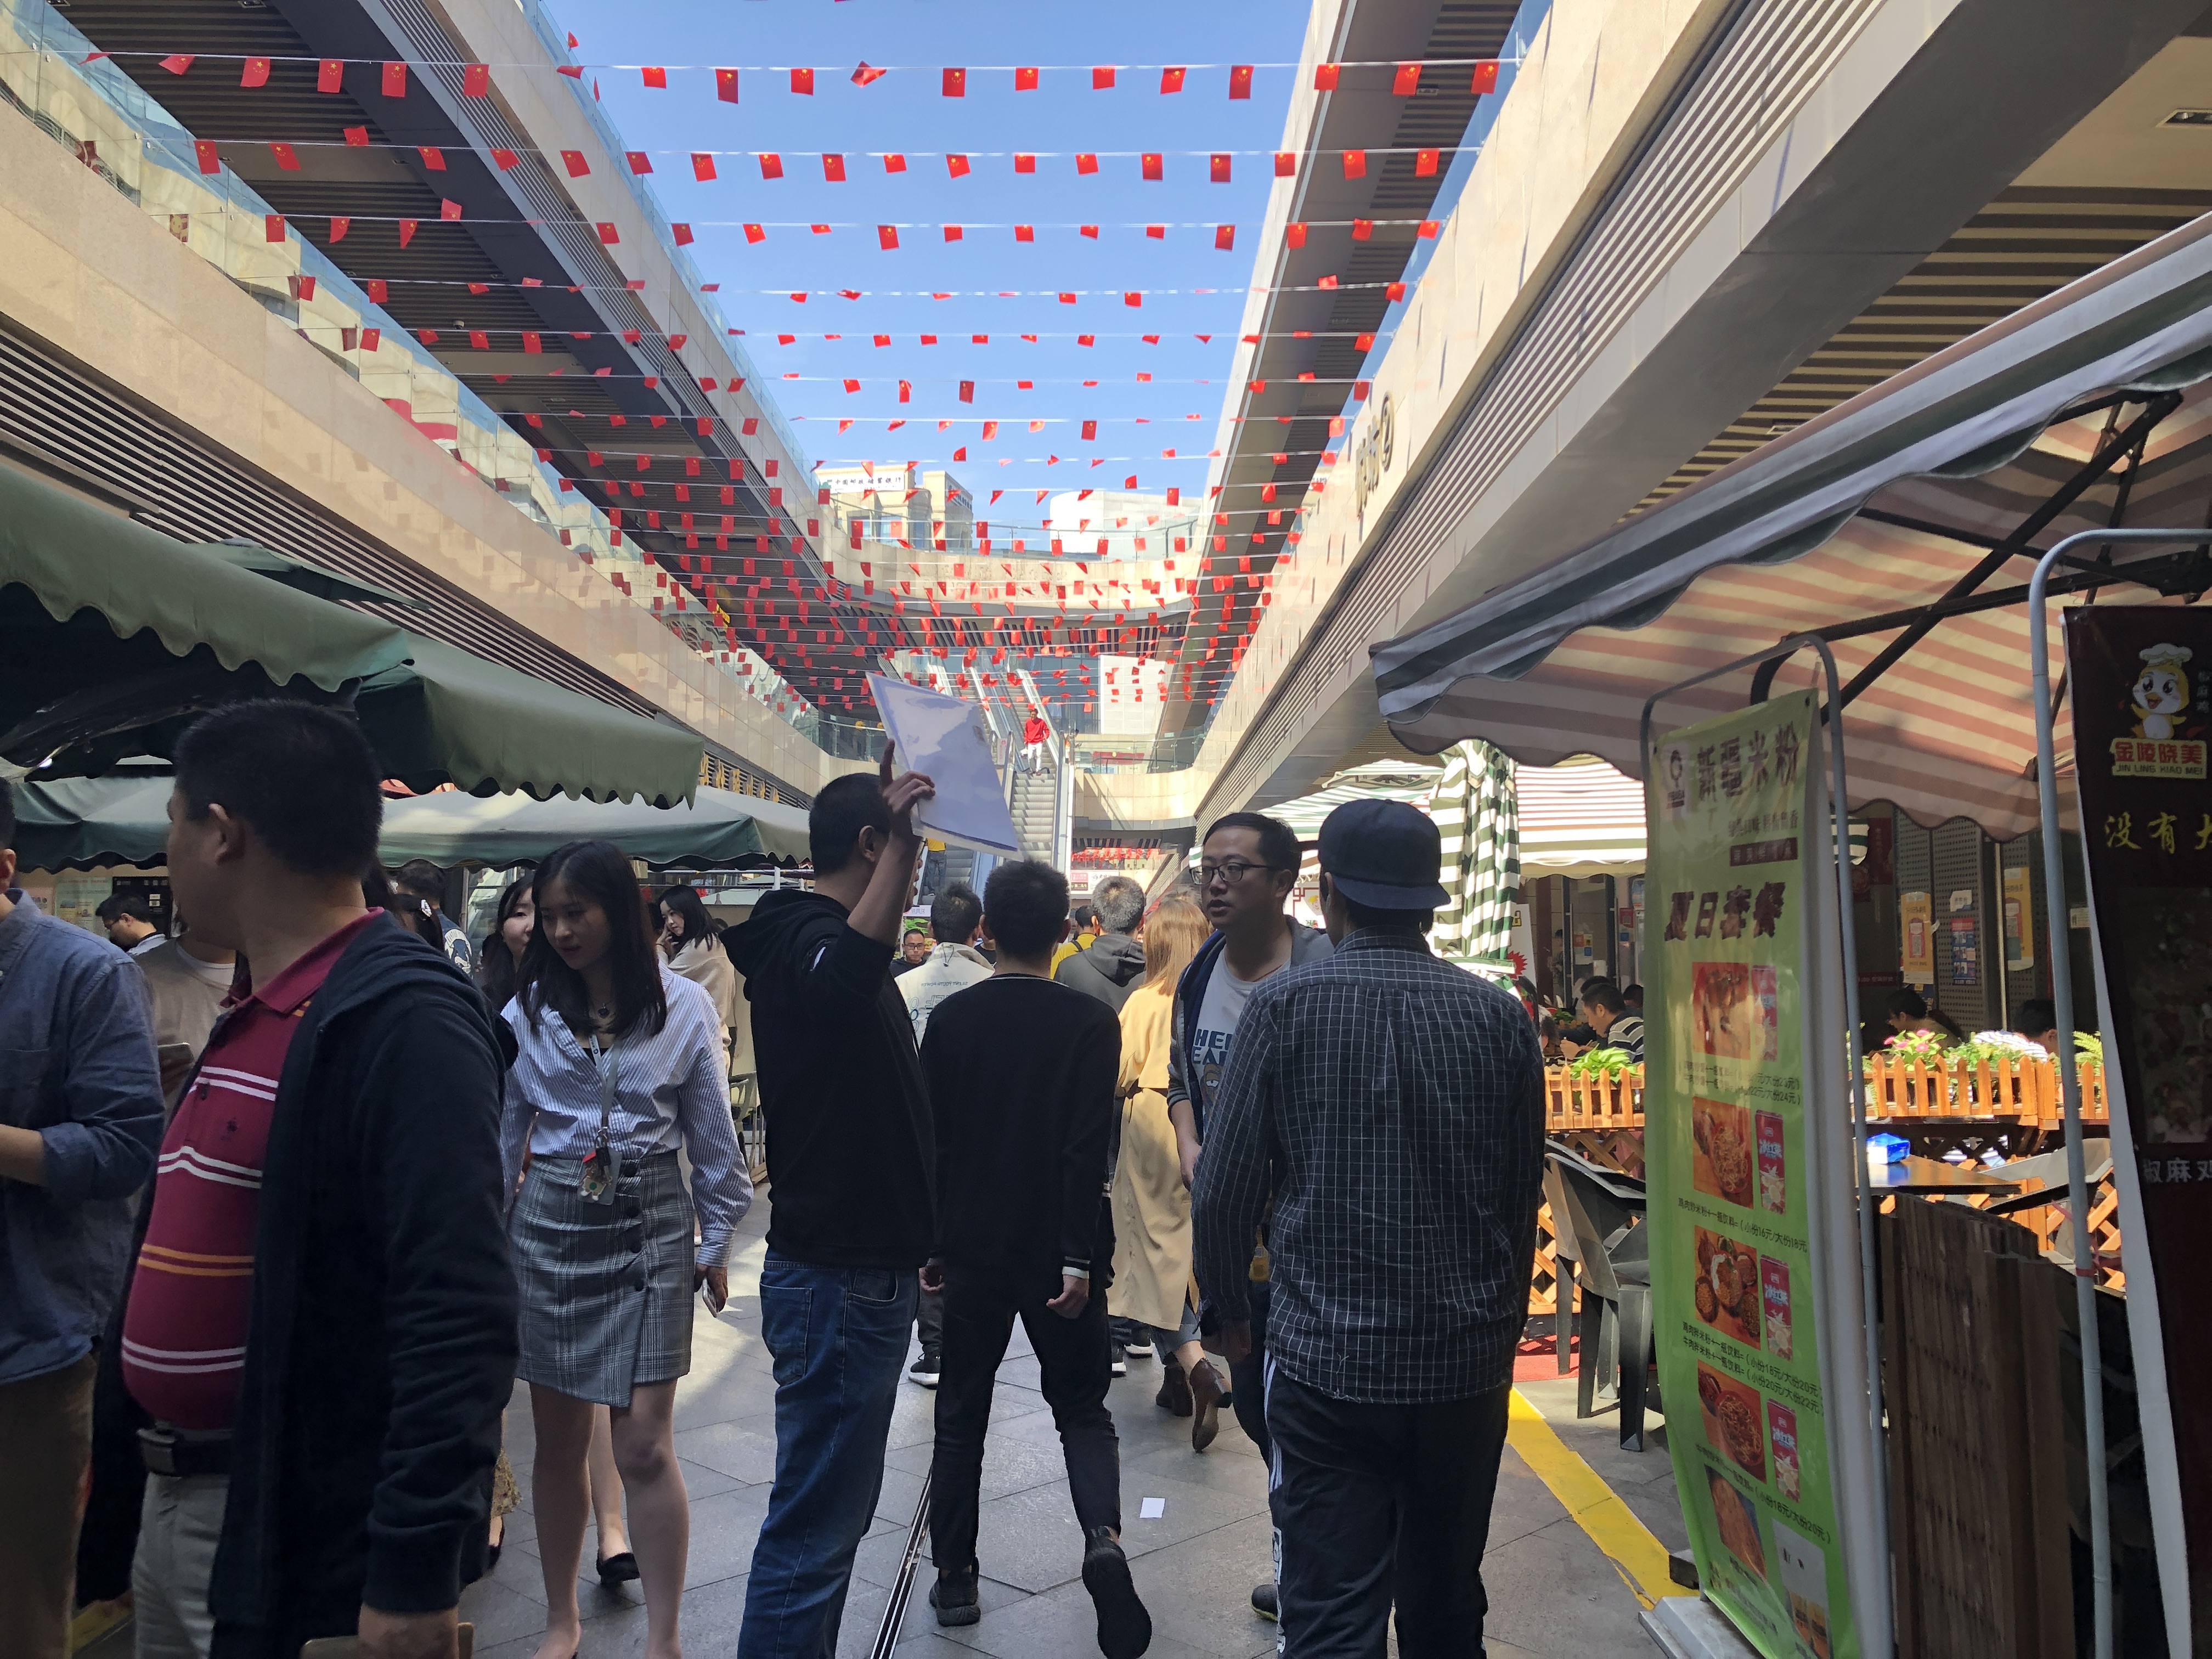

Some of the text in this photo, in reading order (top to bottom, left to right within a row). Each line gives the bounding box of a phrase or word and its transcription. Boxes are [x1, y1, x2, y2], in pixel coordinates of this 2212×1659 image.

[835, 477, 901, 486] 中国邮政储蓄银行
[1697, 721, 1799, 802] 新疆米粉
[2115, 741, 2202, 765] 金陵晓美
[2134, 764, 2157, 773] LING
[2160, 766, 2182, 774] XIAO
[1664, 882, 1786, 941] 夏日套餐
